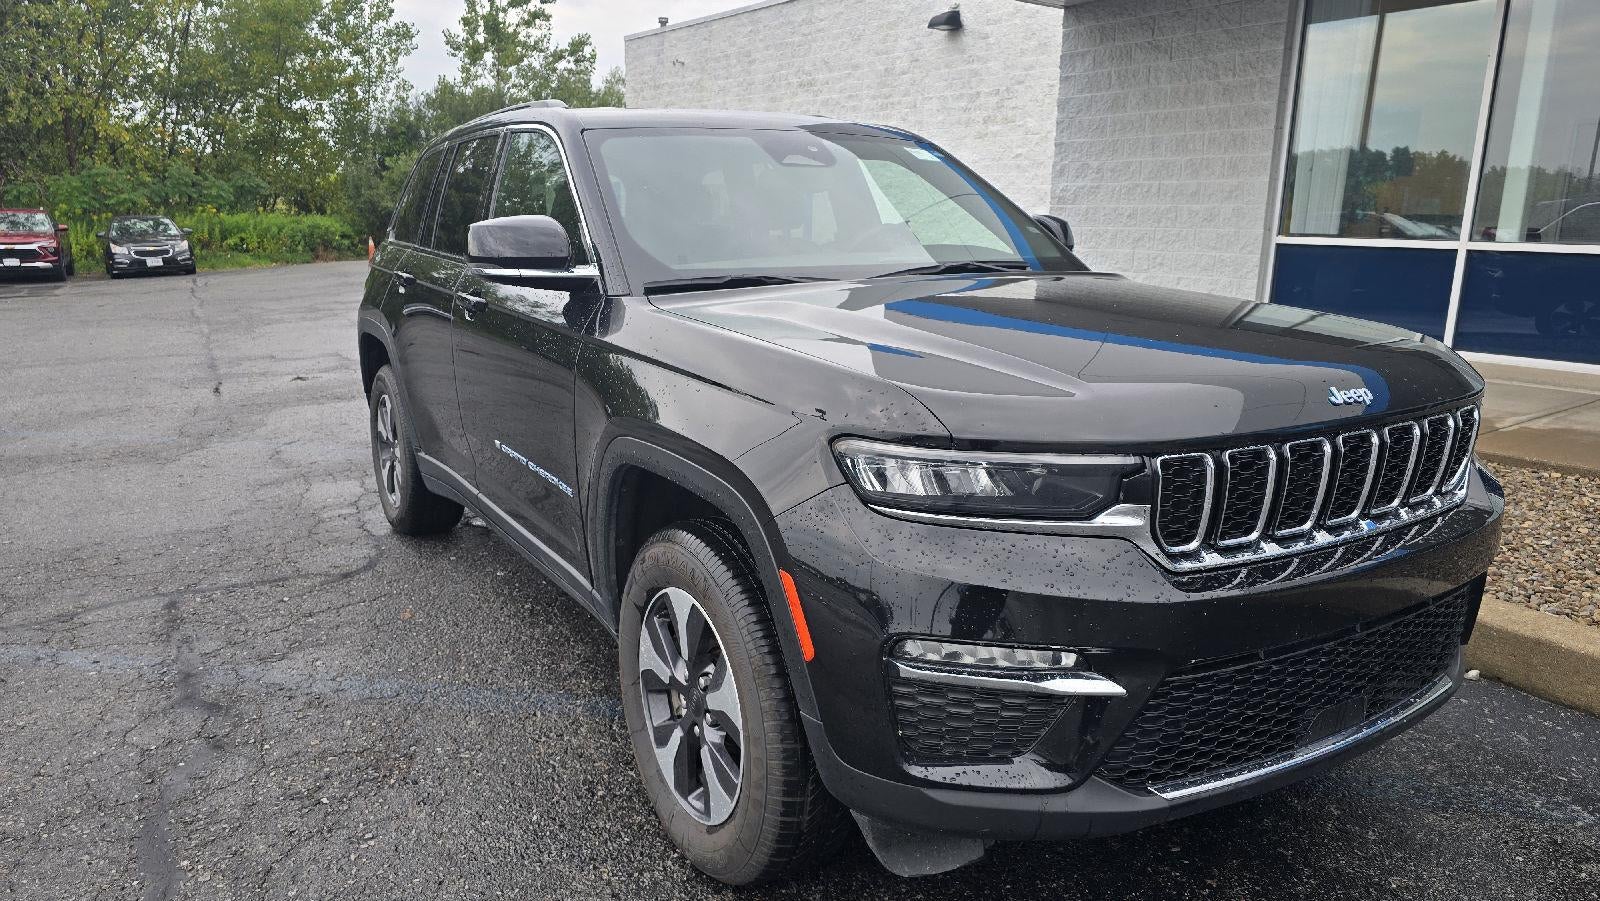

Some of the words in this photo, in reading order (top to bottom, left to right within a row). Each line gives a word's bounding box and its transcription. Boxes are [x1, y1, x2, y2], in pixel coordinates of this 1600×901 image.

[1328, 386, 1374, 406] Jeep
[501, 444, 528, 466] GRAND
[527, 460, 574, 498] CHEROKEE
